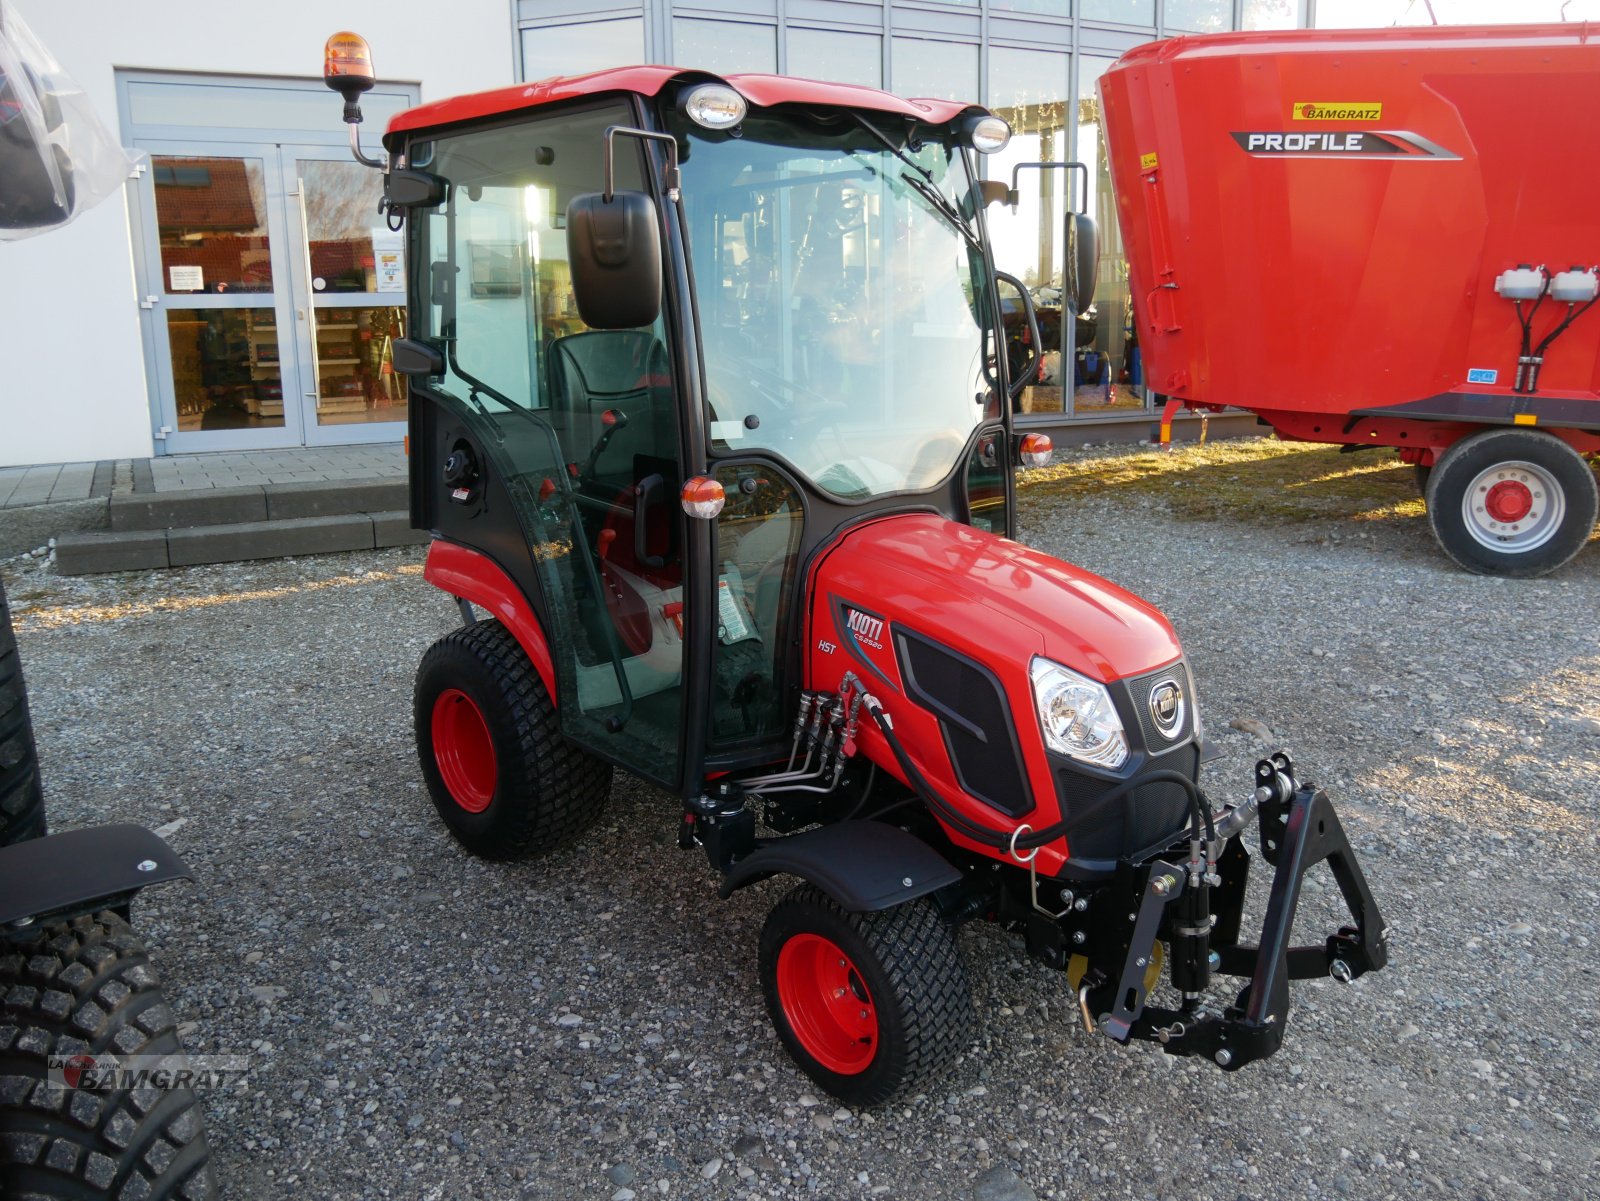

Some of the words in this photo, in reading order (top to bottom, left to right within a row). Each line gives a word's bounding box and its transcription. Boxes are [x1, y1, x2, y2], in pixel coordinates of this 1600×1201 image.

[1307, 110, 1380, 119] BAMGRATZ
[1248, 134, 1363, 150] PROFILE
[847, 609, 883, 640] KIOTI
[818, 639, 837, 655] HST
[854, 633, 883, 650] CS2520
